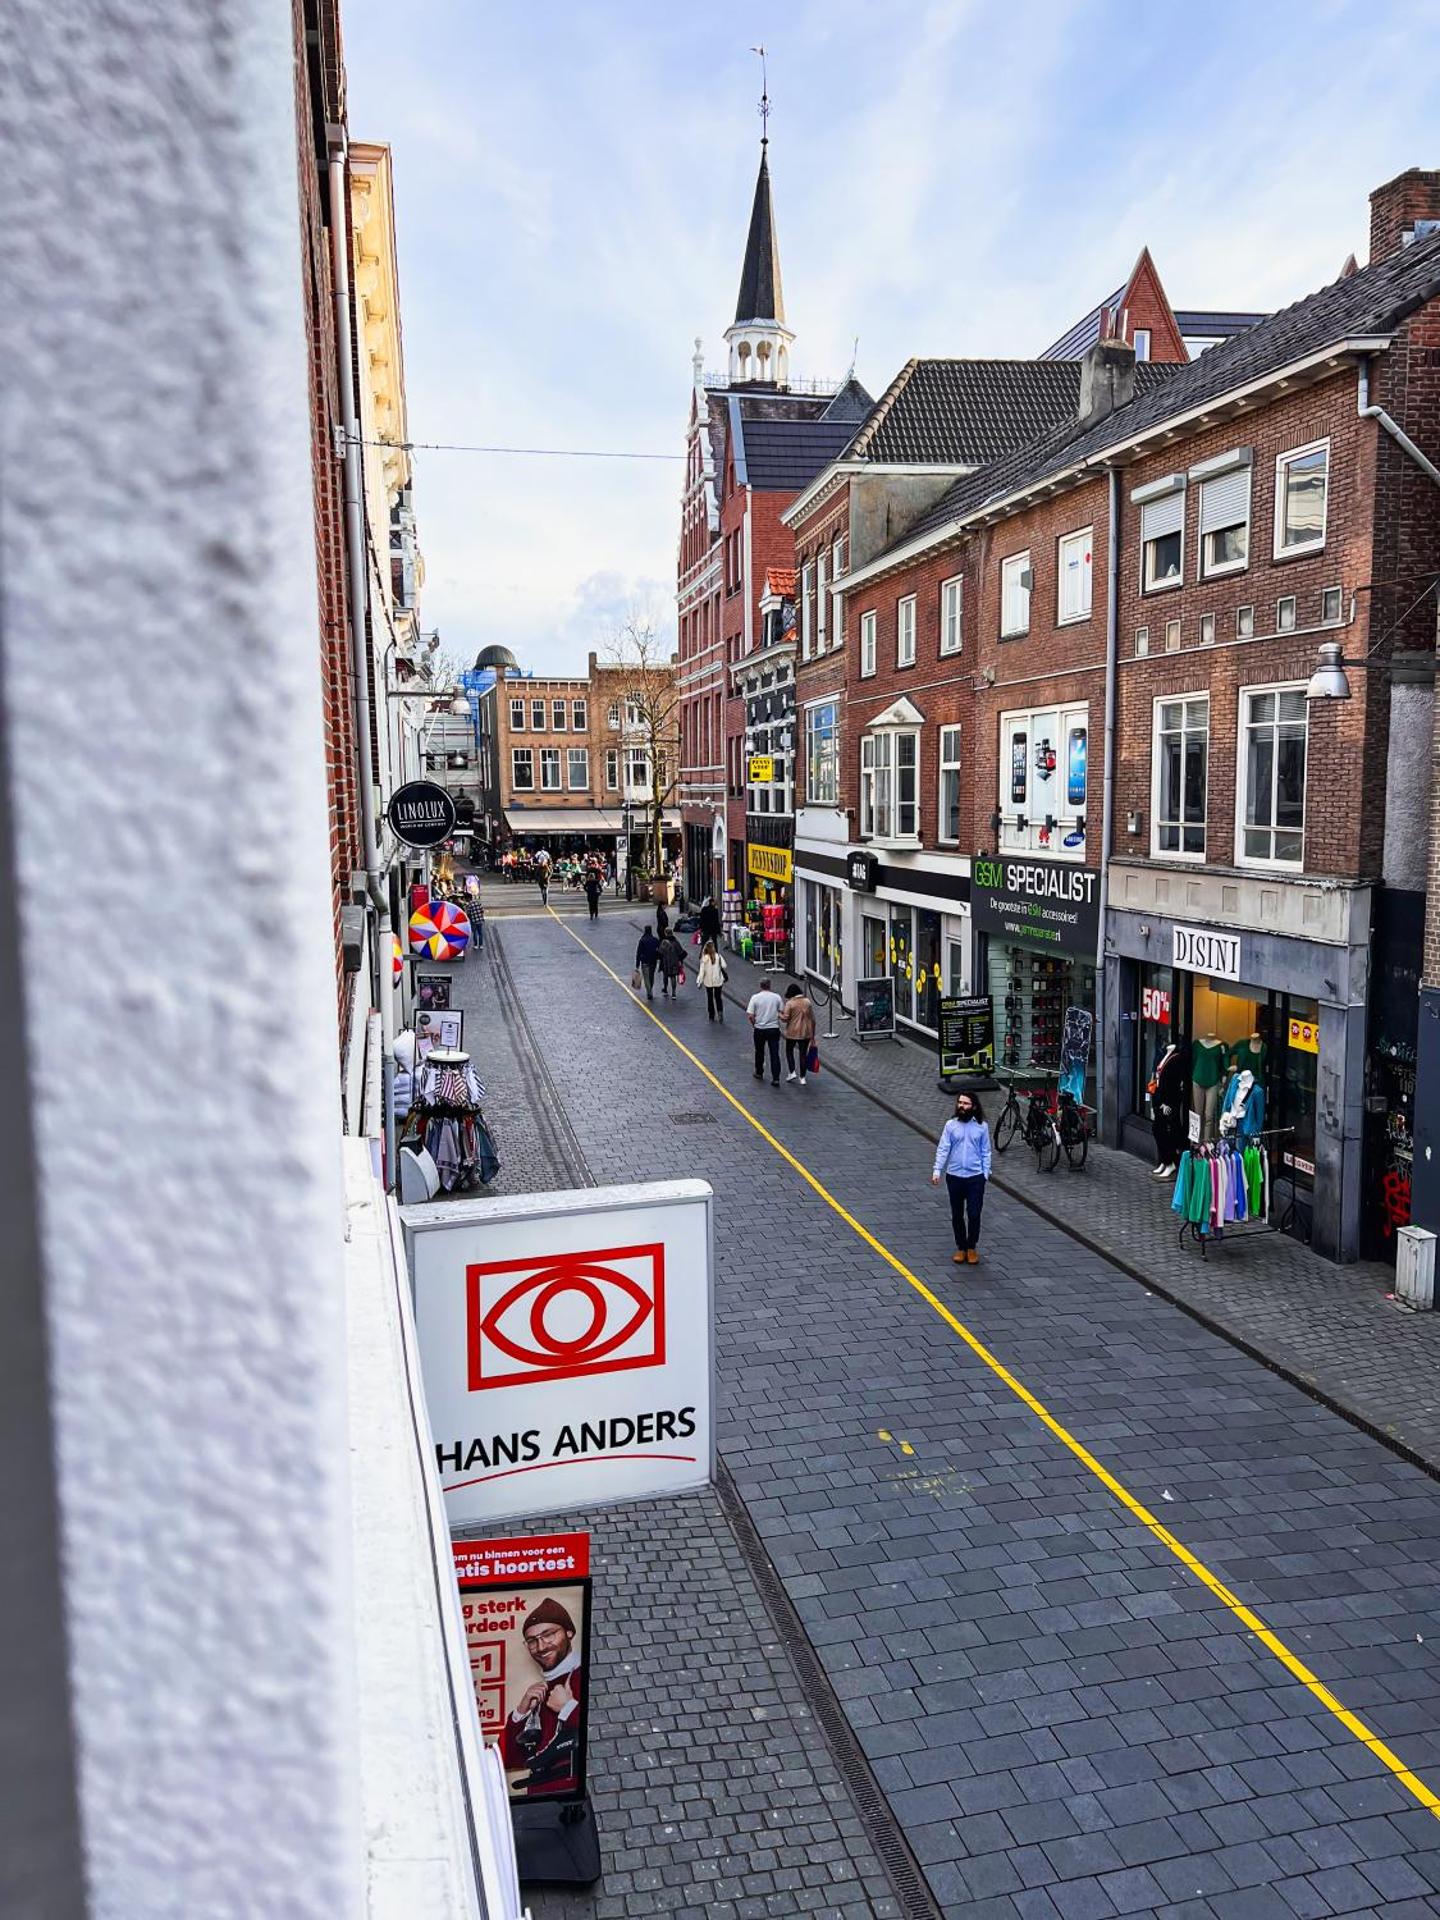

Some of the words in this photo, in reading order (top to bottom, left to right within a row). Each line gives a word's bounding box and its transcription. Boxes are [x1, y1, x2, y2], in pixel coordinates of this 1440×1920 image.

[397, 801, 446, 820] LINOLUX
[974, 861, 1003, 888] GSM
[1006, 864, 1096, 903] SPECIALIST
[990, 897, 998, 909] De
[1175, 931, 1238, 973] DISINI
[1143, 987, 1170, 1021] 50%
[435, 1429, 541, 1474] HANS
[552, 1406, 696, 1458] ANDERS
[453, 1553, 468, 1562] om
[470, 1553, 483, 1561] nu
[485, 1549, 520, 1560] binnen
[521, 1548, 544, 1557] voor
[546, 1546, 565, 1555] een
[456, 1561, 490, 1578] atis
[494, 1555, 575, 1575] hoortest
[478, 1596, 527, 1614] sterk
[465, 1615, 515, 1634] rdeel
[470, 1653, 492, 1672] =1
